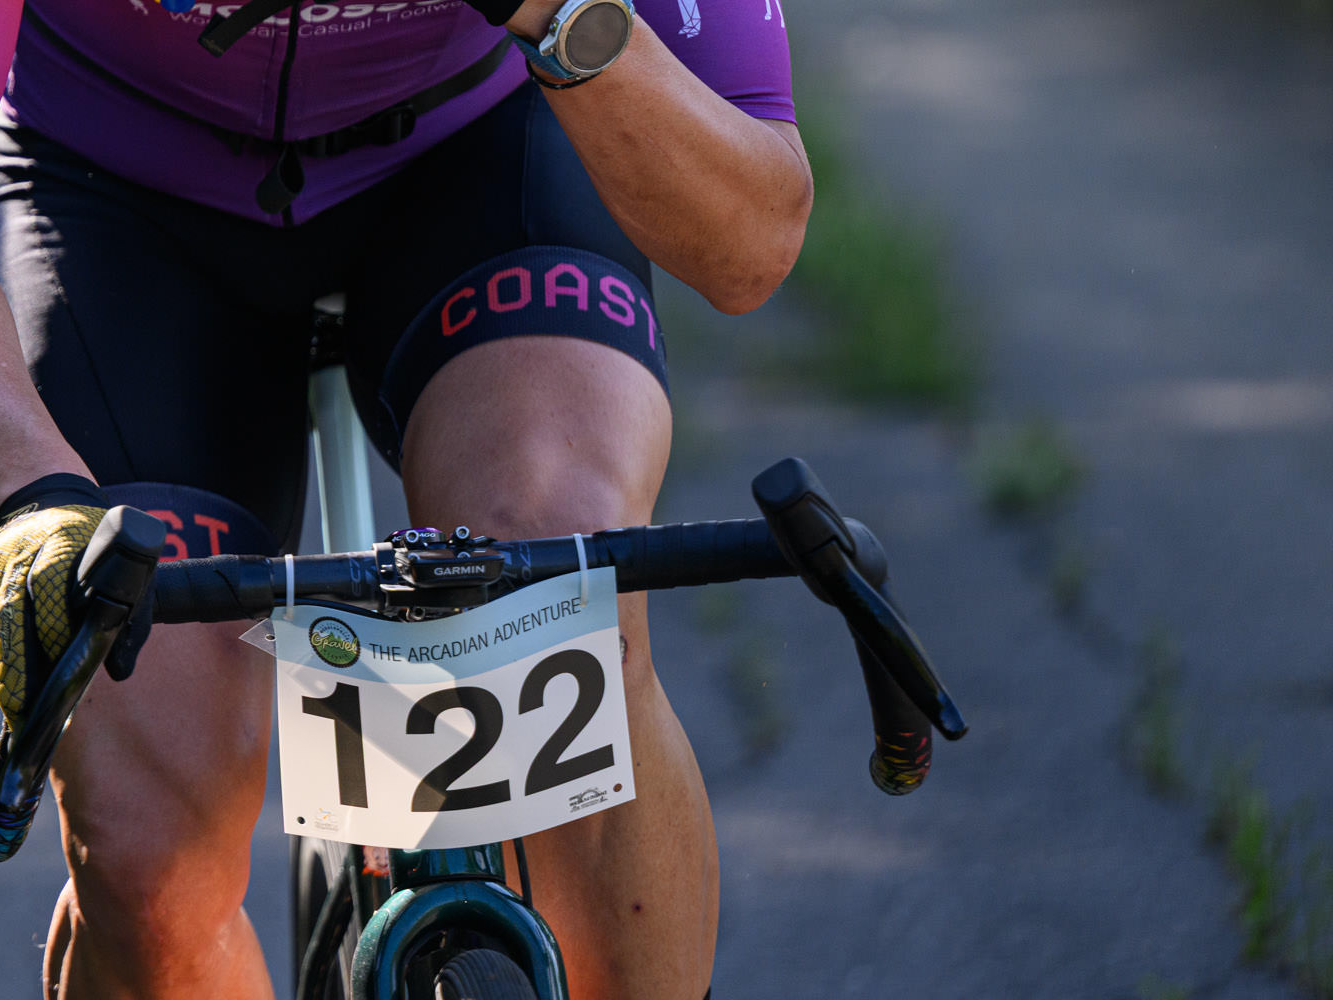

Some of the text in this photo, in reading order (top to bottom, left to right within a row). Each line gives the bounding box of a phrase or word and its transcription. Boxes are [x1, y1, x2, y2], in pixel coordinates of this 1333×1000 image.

[440, 262, 658, 351] COAST
[433, 564, 486, 577] GARMIN
[369, 596, 582, 662] THE ARCADIAN ADVENTURE
[301, 648, 616, 813] 122
